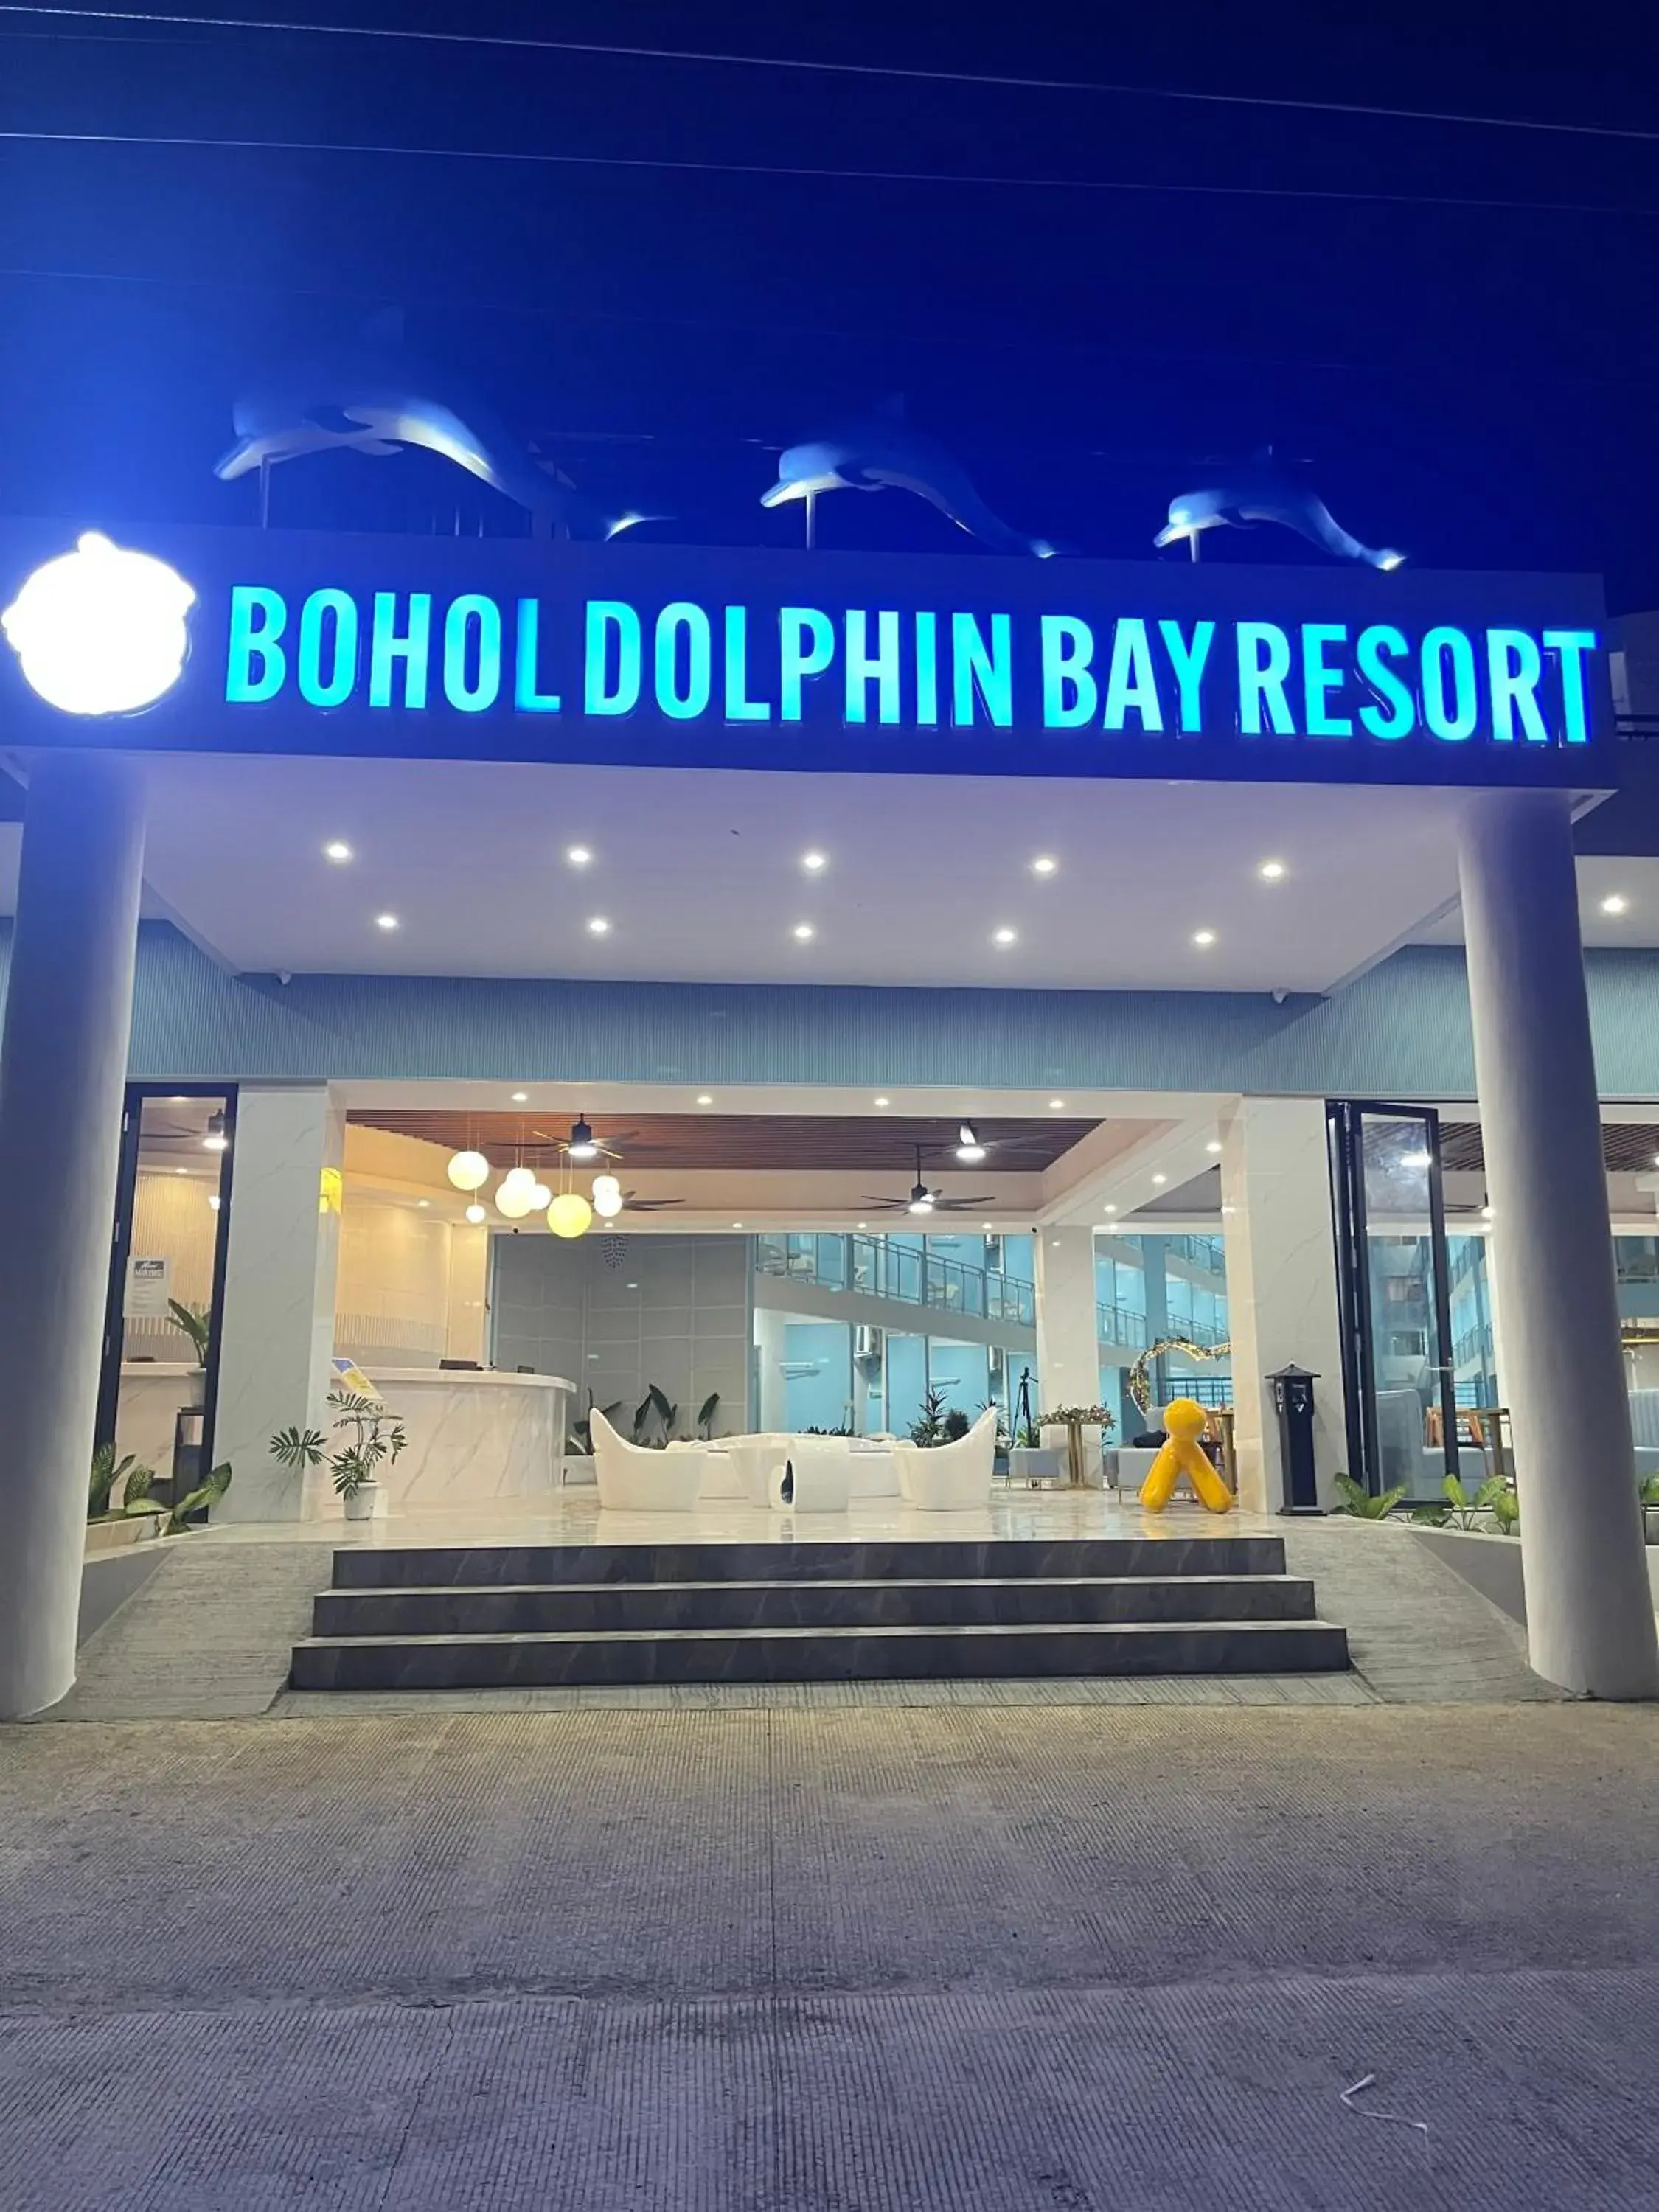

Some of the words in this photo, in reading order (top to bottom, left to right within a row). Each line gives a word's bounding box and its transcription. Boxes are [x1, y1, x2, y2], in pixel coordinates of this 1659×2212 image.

[226, 586, 560, 712] BOHOL
[585, 600, 1013, 727] DOLPHIN
[1041, 615, 1216, 732] BAY
[1236, 622, 1596, 743] RESORT
